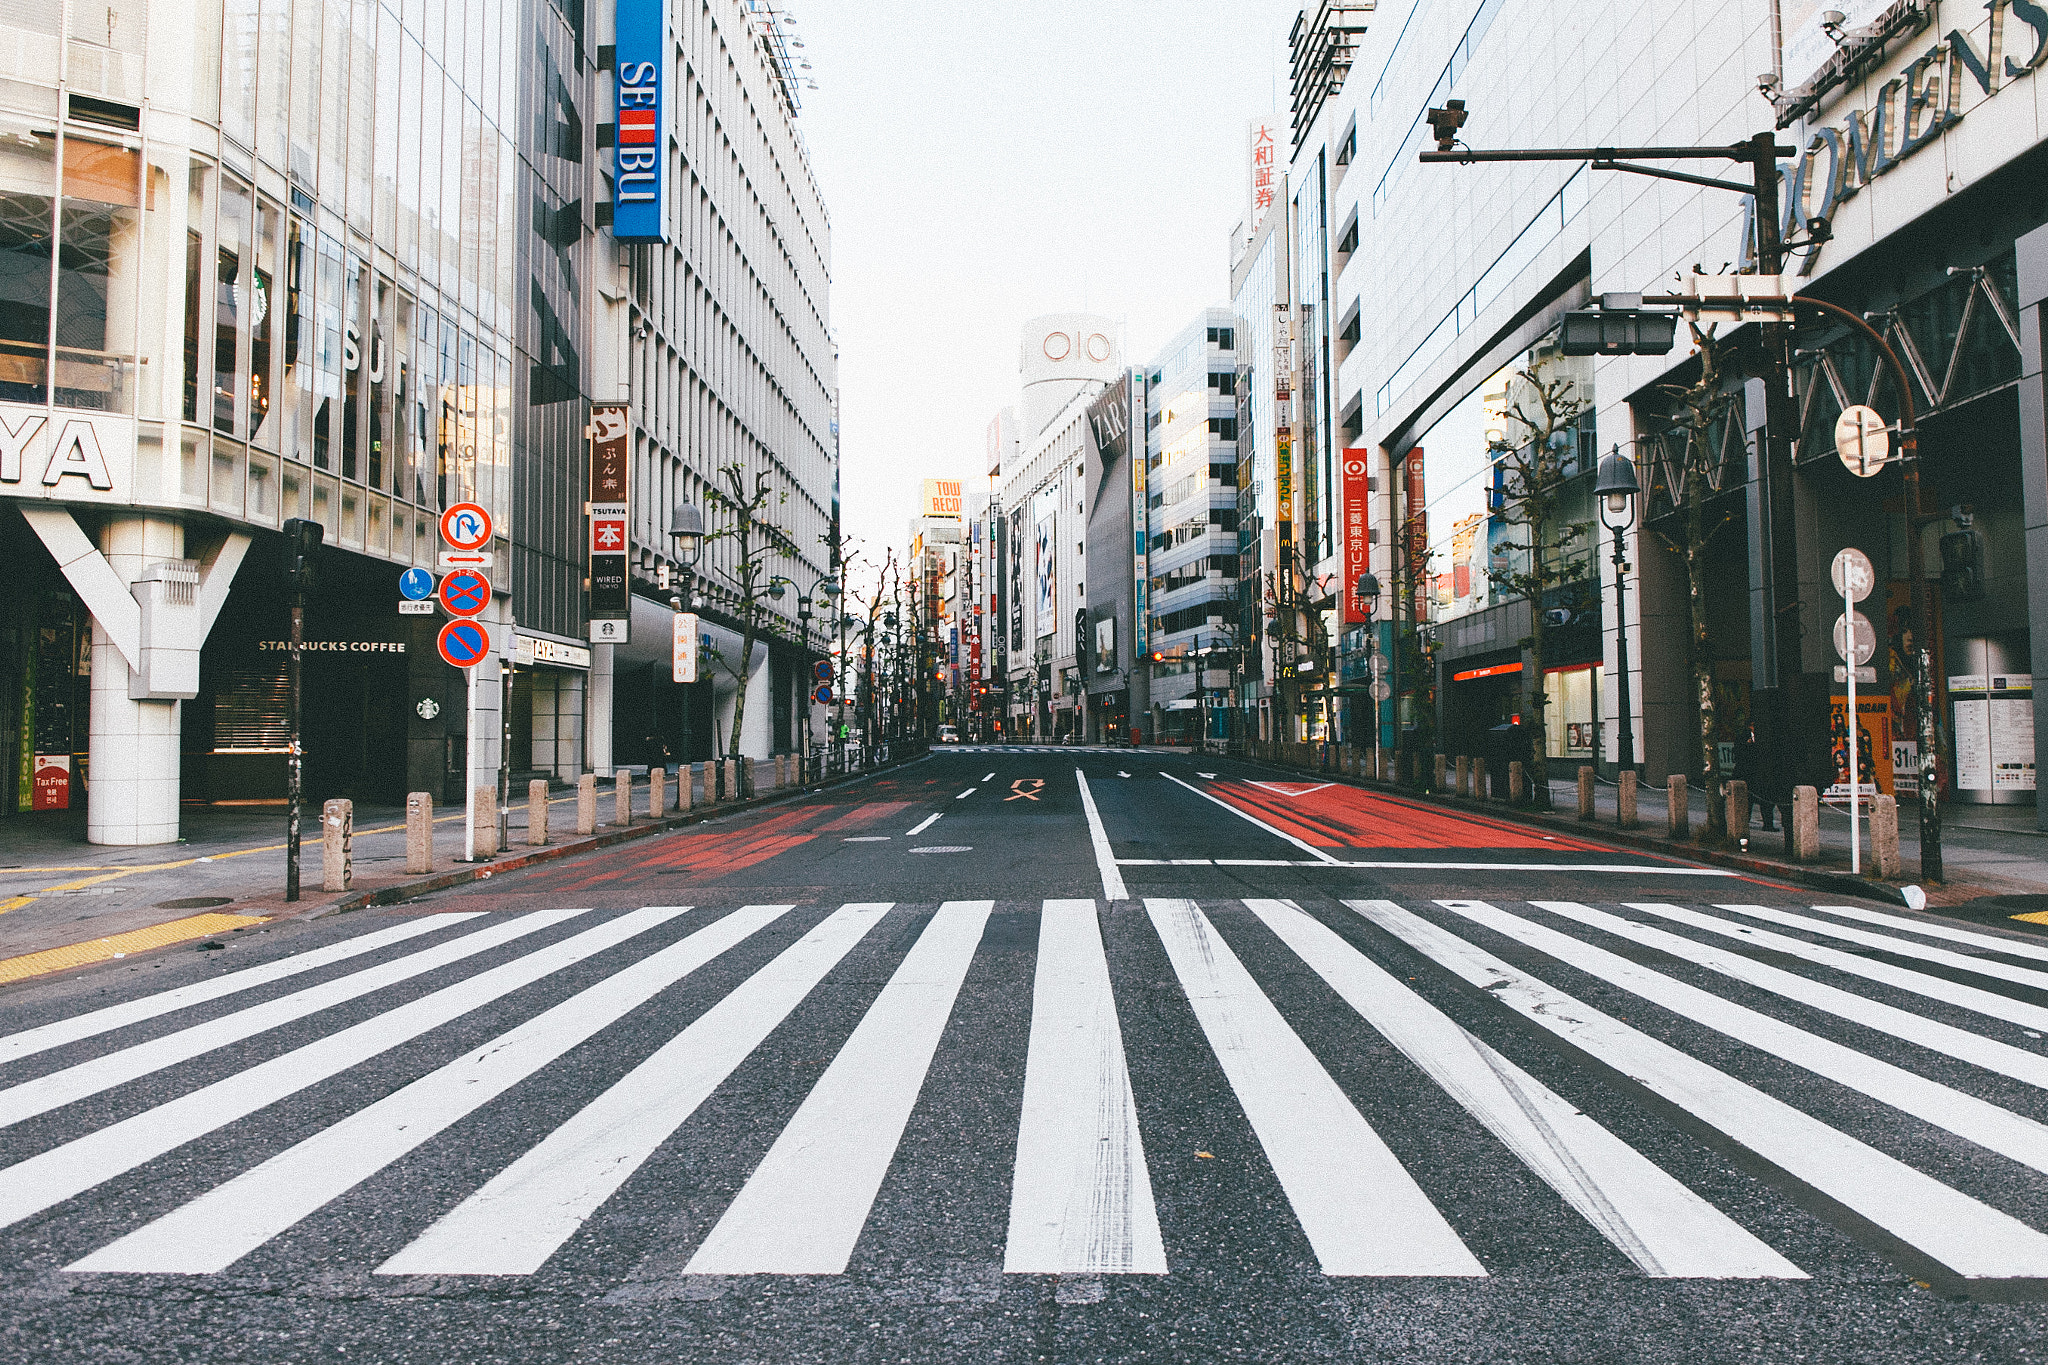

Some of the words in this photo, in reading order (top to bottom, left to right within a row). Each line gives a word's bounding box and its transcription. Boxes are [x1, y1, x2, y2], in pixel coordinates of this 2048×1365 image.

[618, 61, 657, 206] SEIBU
[1253, 124, 1275, 210] 大和証券
[597, 523, 621, 548] 本
[596, 576, 623, 584] WIRED
[350, 642, 406, 653] COFFEE
[36, 777, 50, 787] Tax
[51, 777, 68, 786] Free
